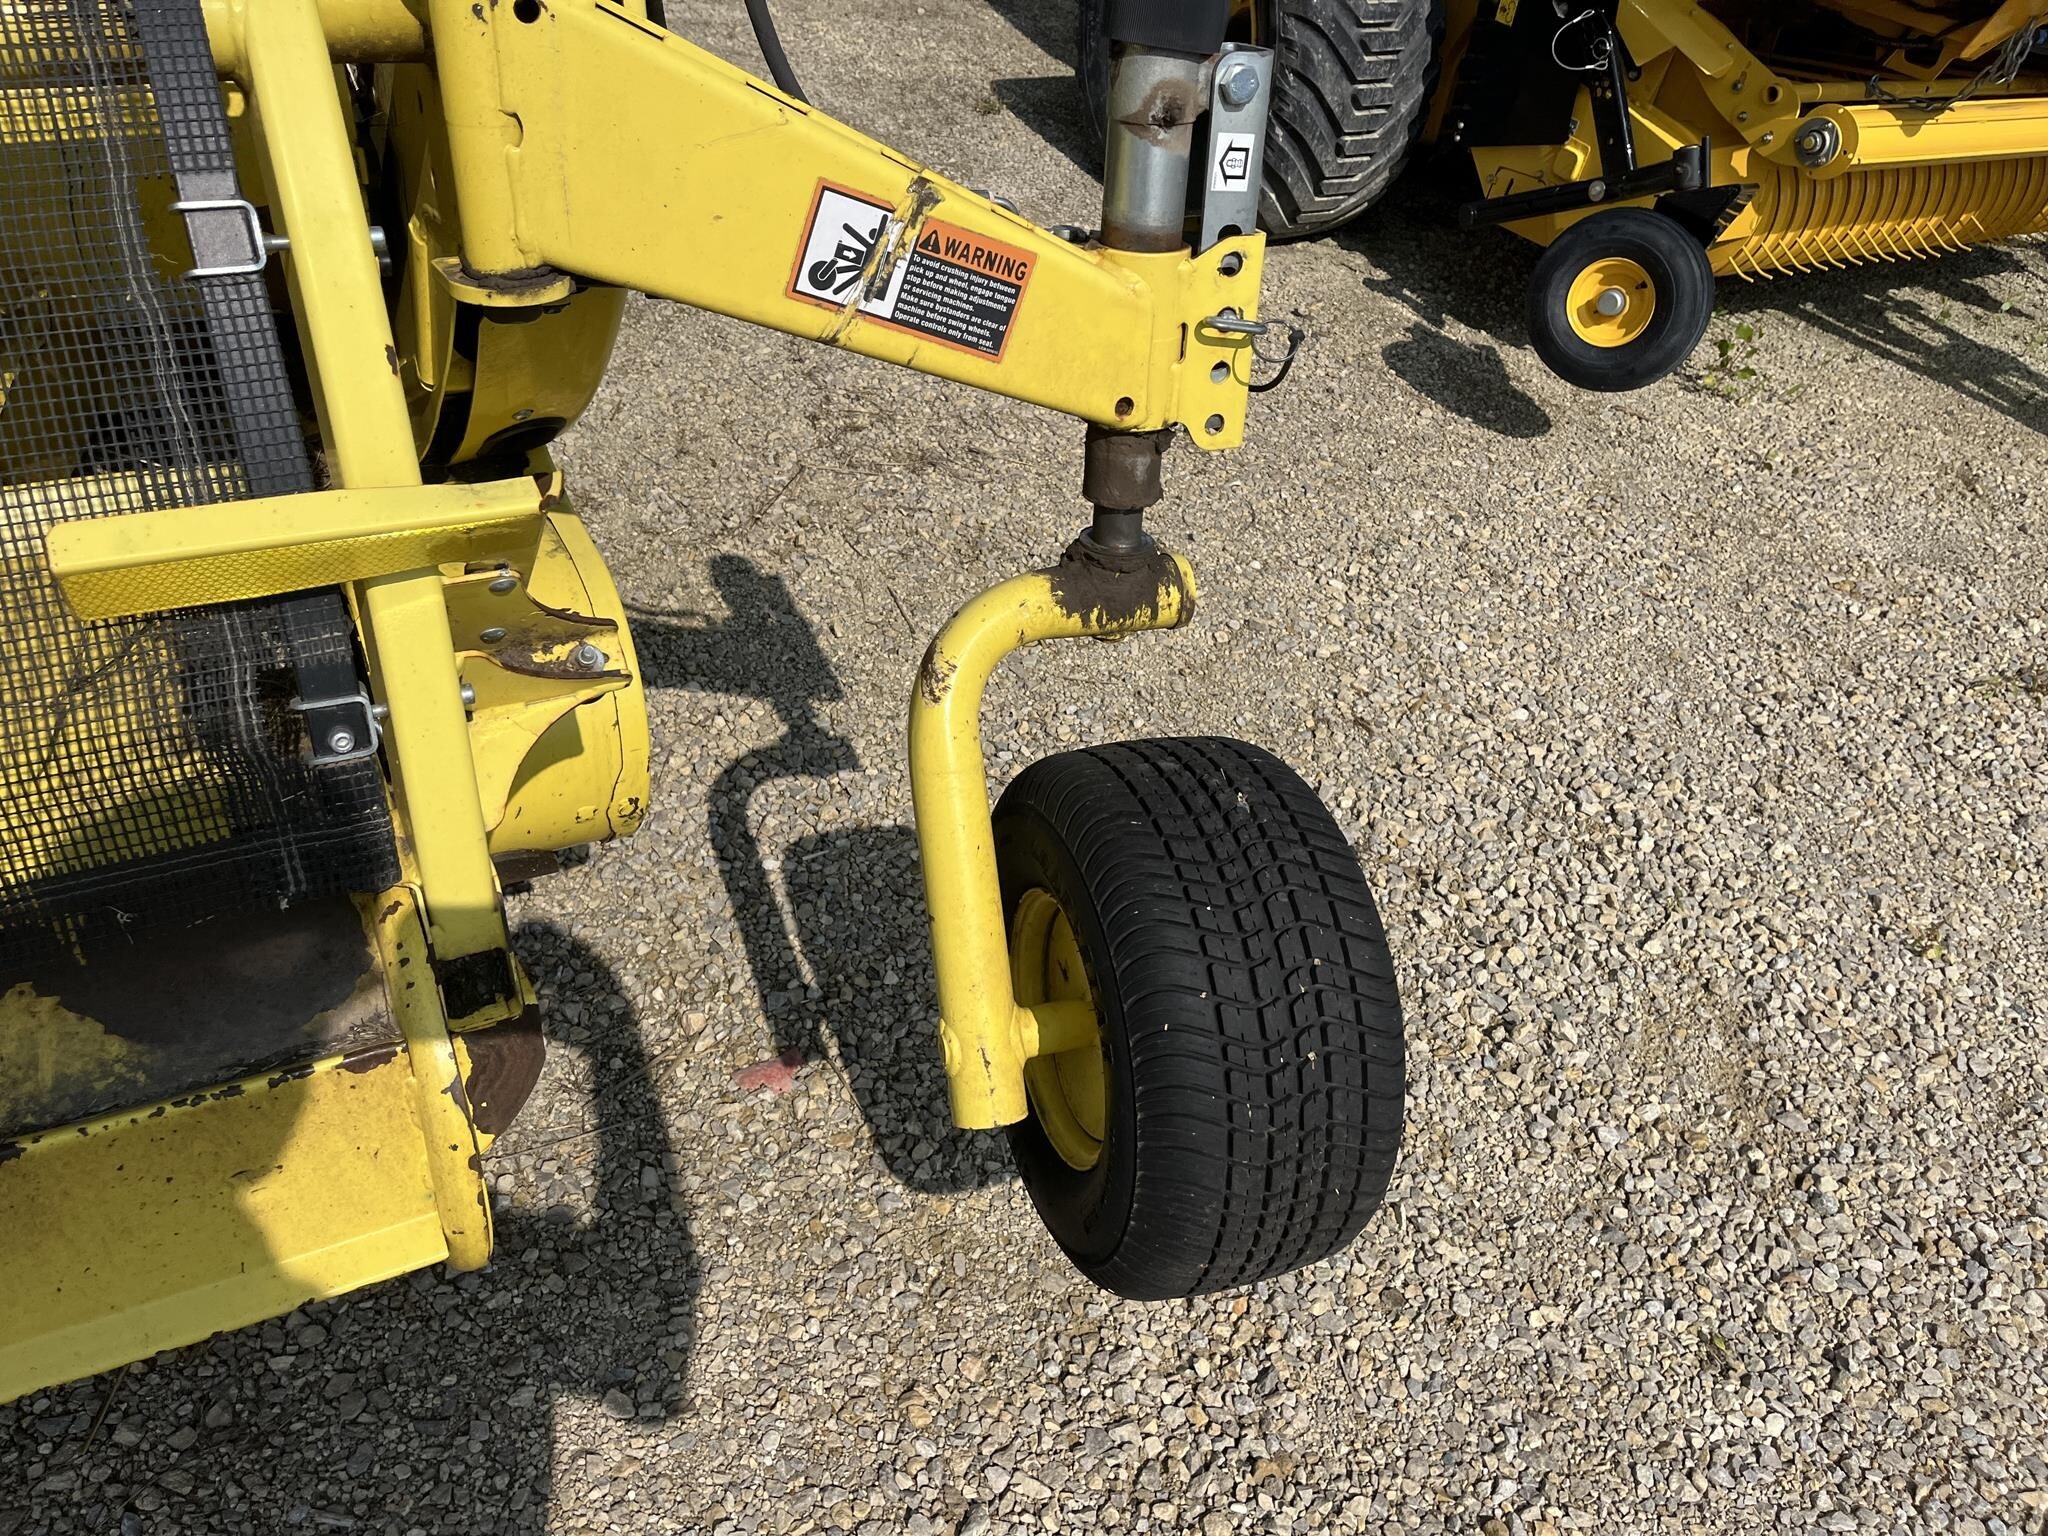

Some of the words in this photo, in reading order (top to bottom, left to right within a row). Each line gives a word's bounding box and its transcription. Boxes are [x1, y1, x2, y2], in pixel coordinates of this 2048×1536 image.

[913, 254, 920, 262] To
[922, 258, 940, 268] avoid
[940, 264, 969, 280] crushing
[970, 273, 988, 286] injury
[989, 280, 1016, 294] between
[944, 236, 1028, 281] WARNING
[906, 274, 921, 284] stop
[922, 278, 943, 290] before
[944, 286, 968, 300] making
[969, 294, 1007, 312] adjustments
[909, 264, 924, 274] pick
[925, 270, 934, 278] up
[934, 273, 948, 282] and
[948, 277, 969, 290] wheel,
[970, 284, 994, 298] engage
[994, 292, 1016, 304] tongue
[912, 287, 942, 301] servicing
[942, 297, 974, 311] machines.
[894, 311, 920, 324] Operate
[921, 320, 947, 333] controls
[948, 328, 962, 338] only
[963, 332, 977, 343] from
[978, 339, 993, 348] seat.
[898, 302, 925, 316] machine
[926, 310, 946, 323] before
[948, 319, 967, 330] swing
[968, 325, 990, 337] wheels.
[900, 292, 918, 303] Make
[920, 299, 934, 308] sure
[935, 303, 970, 320] bystanders
[982, 320, 998, 330] clear
